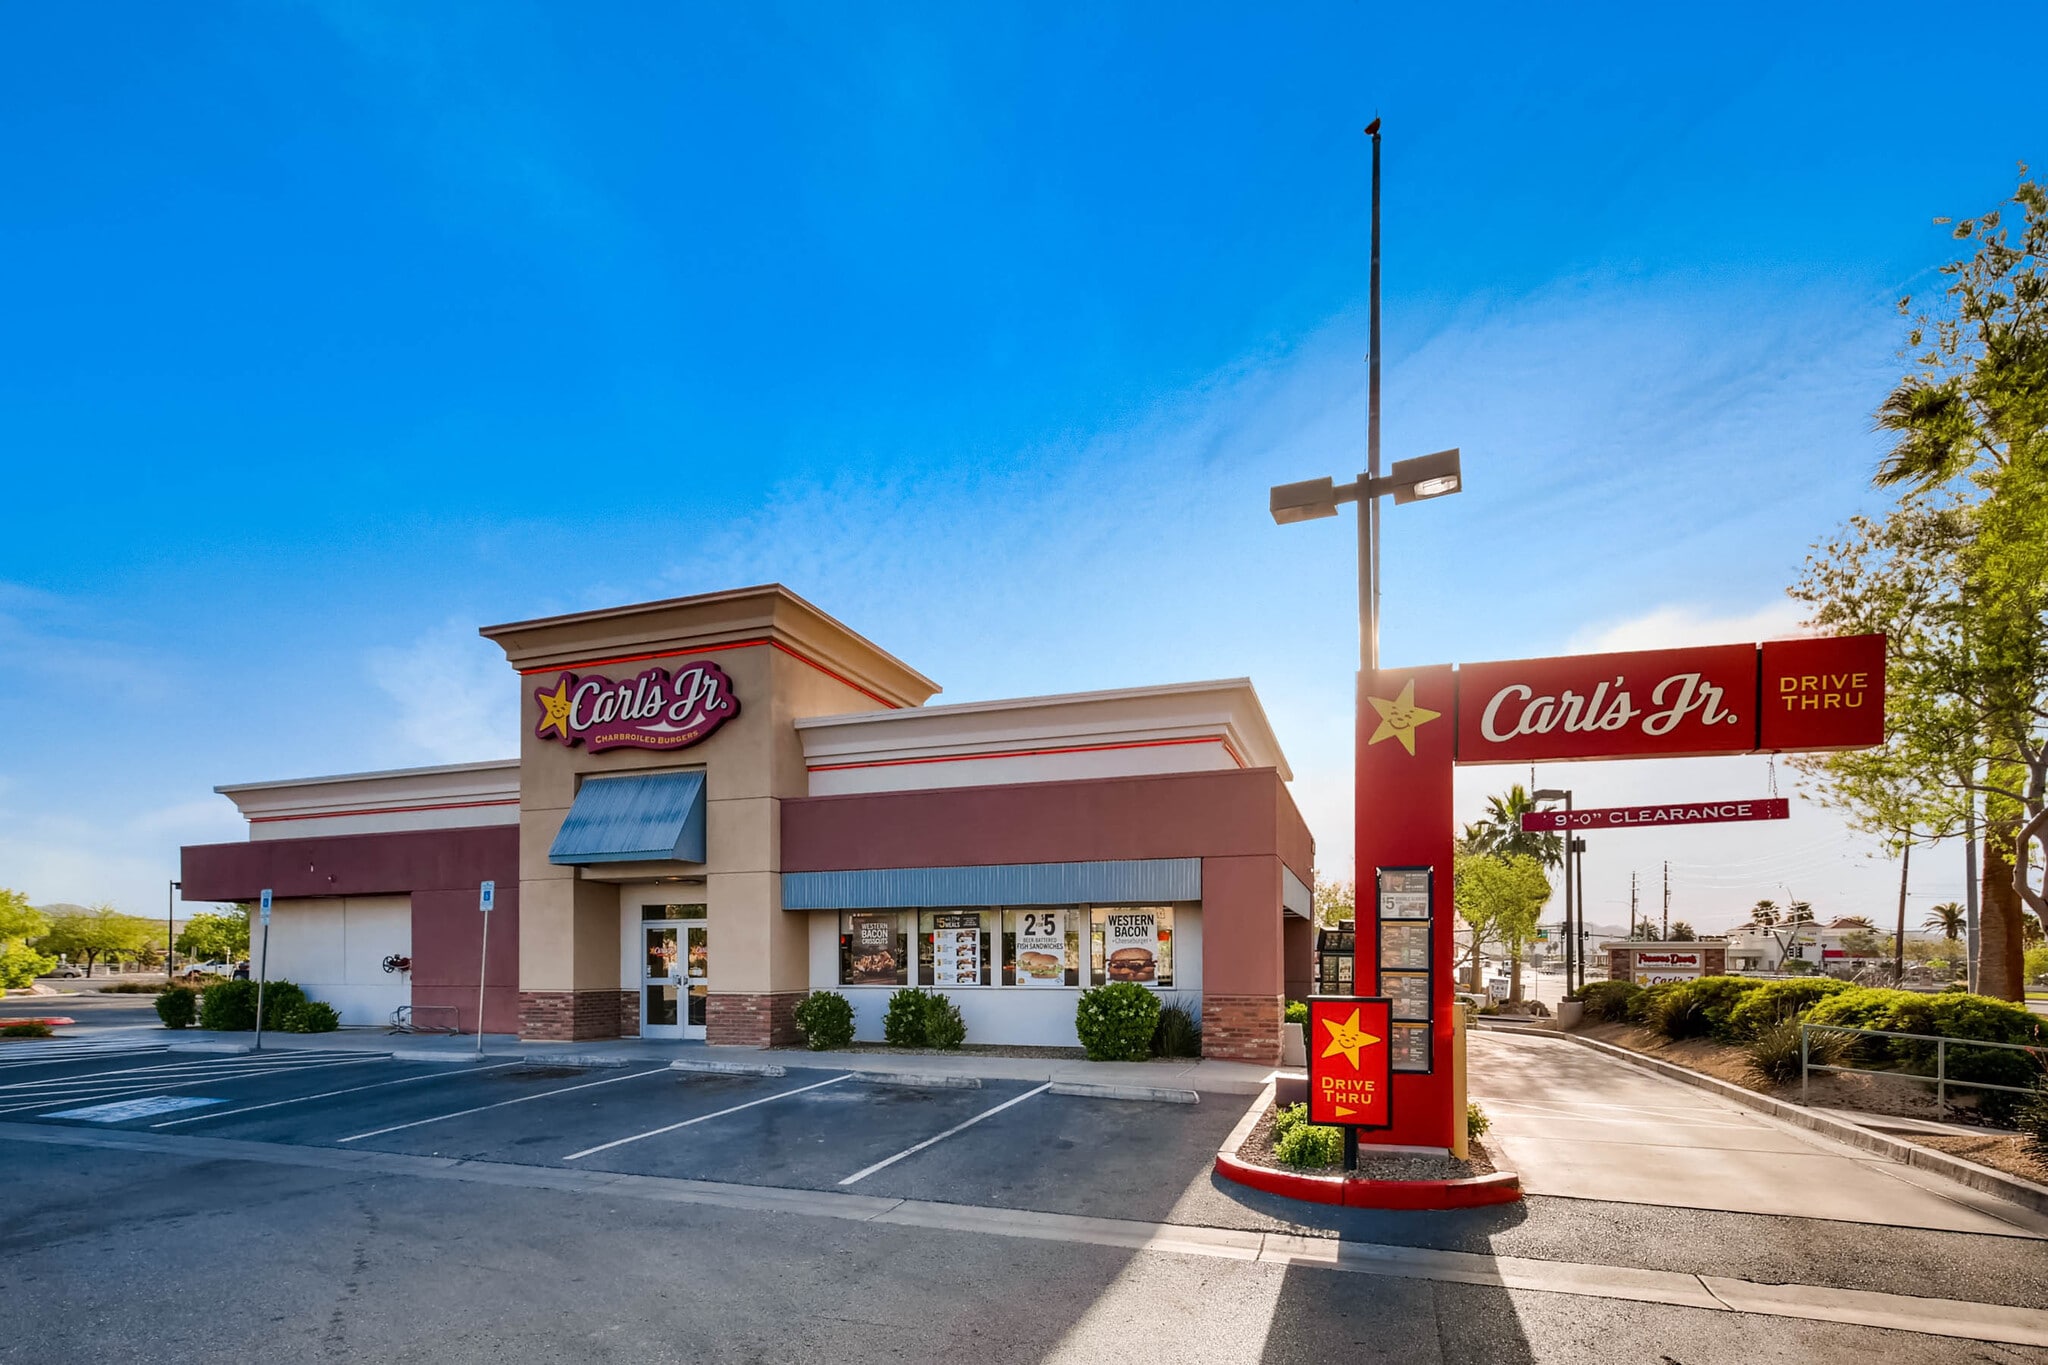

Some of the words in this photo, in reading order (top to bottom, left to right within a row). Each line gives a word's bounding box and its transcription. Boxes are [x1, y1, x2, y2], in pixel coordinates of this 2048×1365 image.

[1780, 672, 1869, 694] DRIVE
[569, 672, 667, 731] Carl's
[668, 668, 727, 721] Jr.
[1480, 676, 1640, 743] Carl's
[1641, 673, 1738, 736] Jr.
[1782, 692, 1864, 712] THRU
[1608, 804, 1753, 825] CLEARANCE
[1024, 913, 1036, 936] 2
[1108, 914, 1154, 926] WESTERN
[861, 930, 889, 938] BACON
[1114, 926, 1148, 937] BACON
[1322, 1076, 1375, 1092] DRIVE
[1323, 1090, 1372, 1105] THRU
